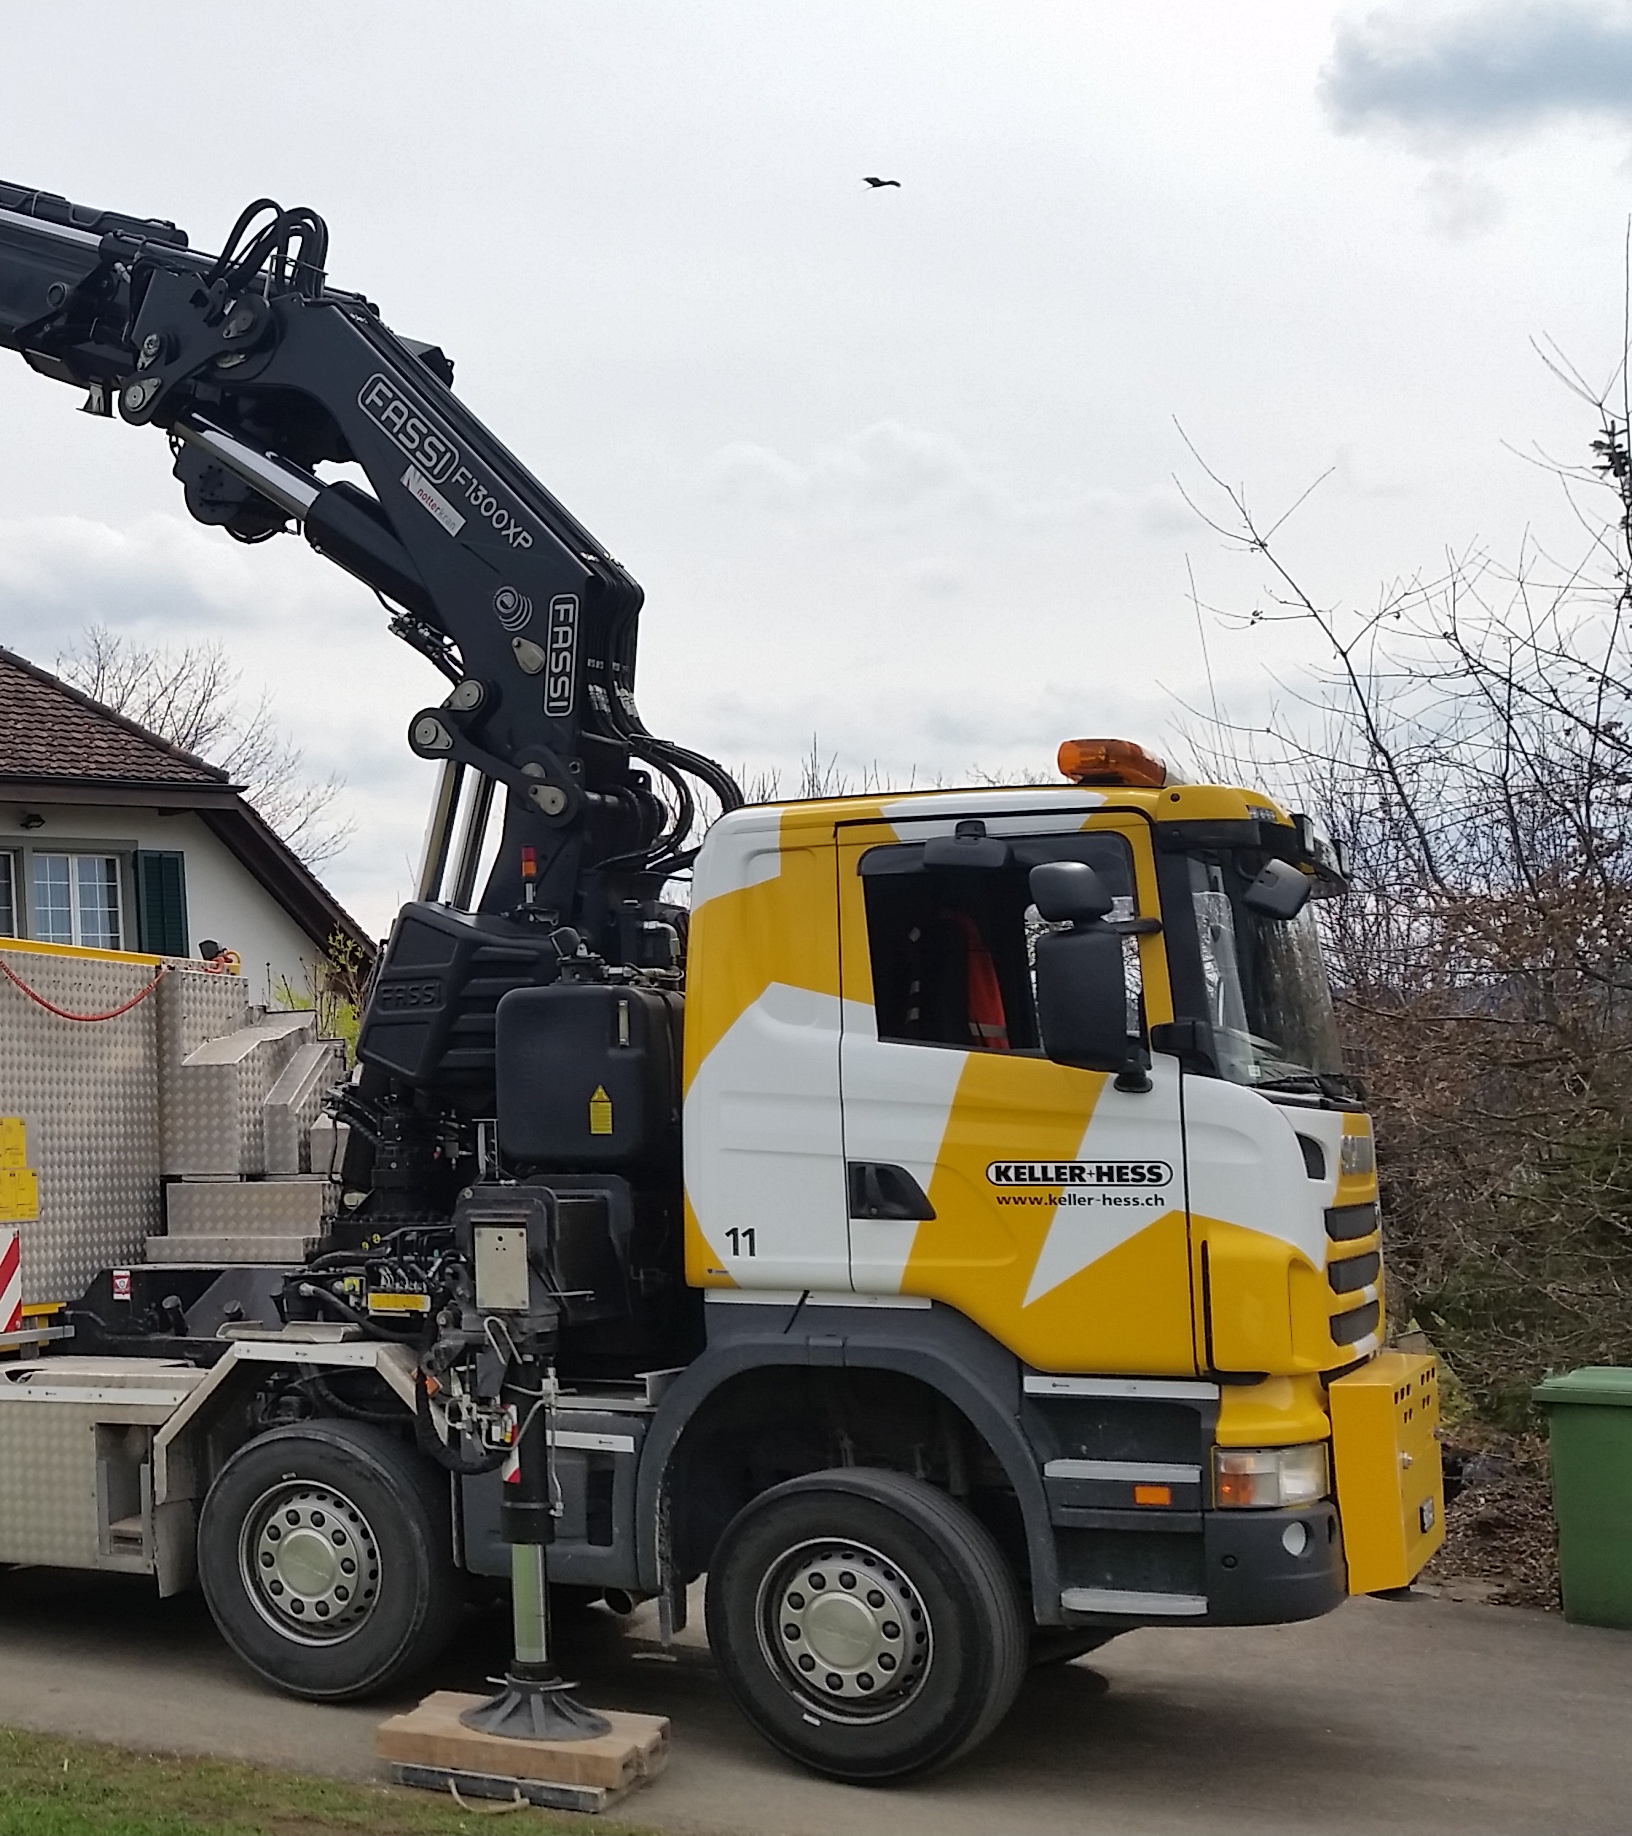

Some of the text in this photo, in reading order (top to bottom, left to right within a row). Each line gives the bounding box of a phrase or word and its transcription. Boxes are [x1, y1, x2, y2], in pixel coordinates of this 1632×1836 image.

[365, 382, 451, 475] FASSI
[451, 466, 534, 549] F1300XP
[549, 603, 574, 707] FASSI
[381, 983, 441, 1006] FASSI
[994, 1165, 1164, 1184] KELLER+HESS
[996, 1193, 1165, 1207] www.keller-hess.ch
[724, 1227, 756, 1257] 11
